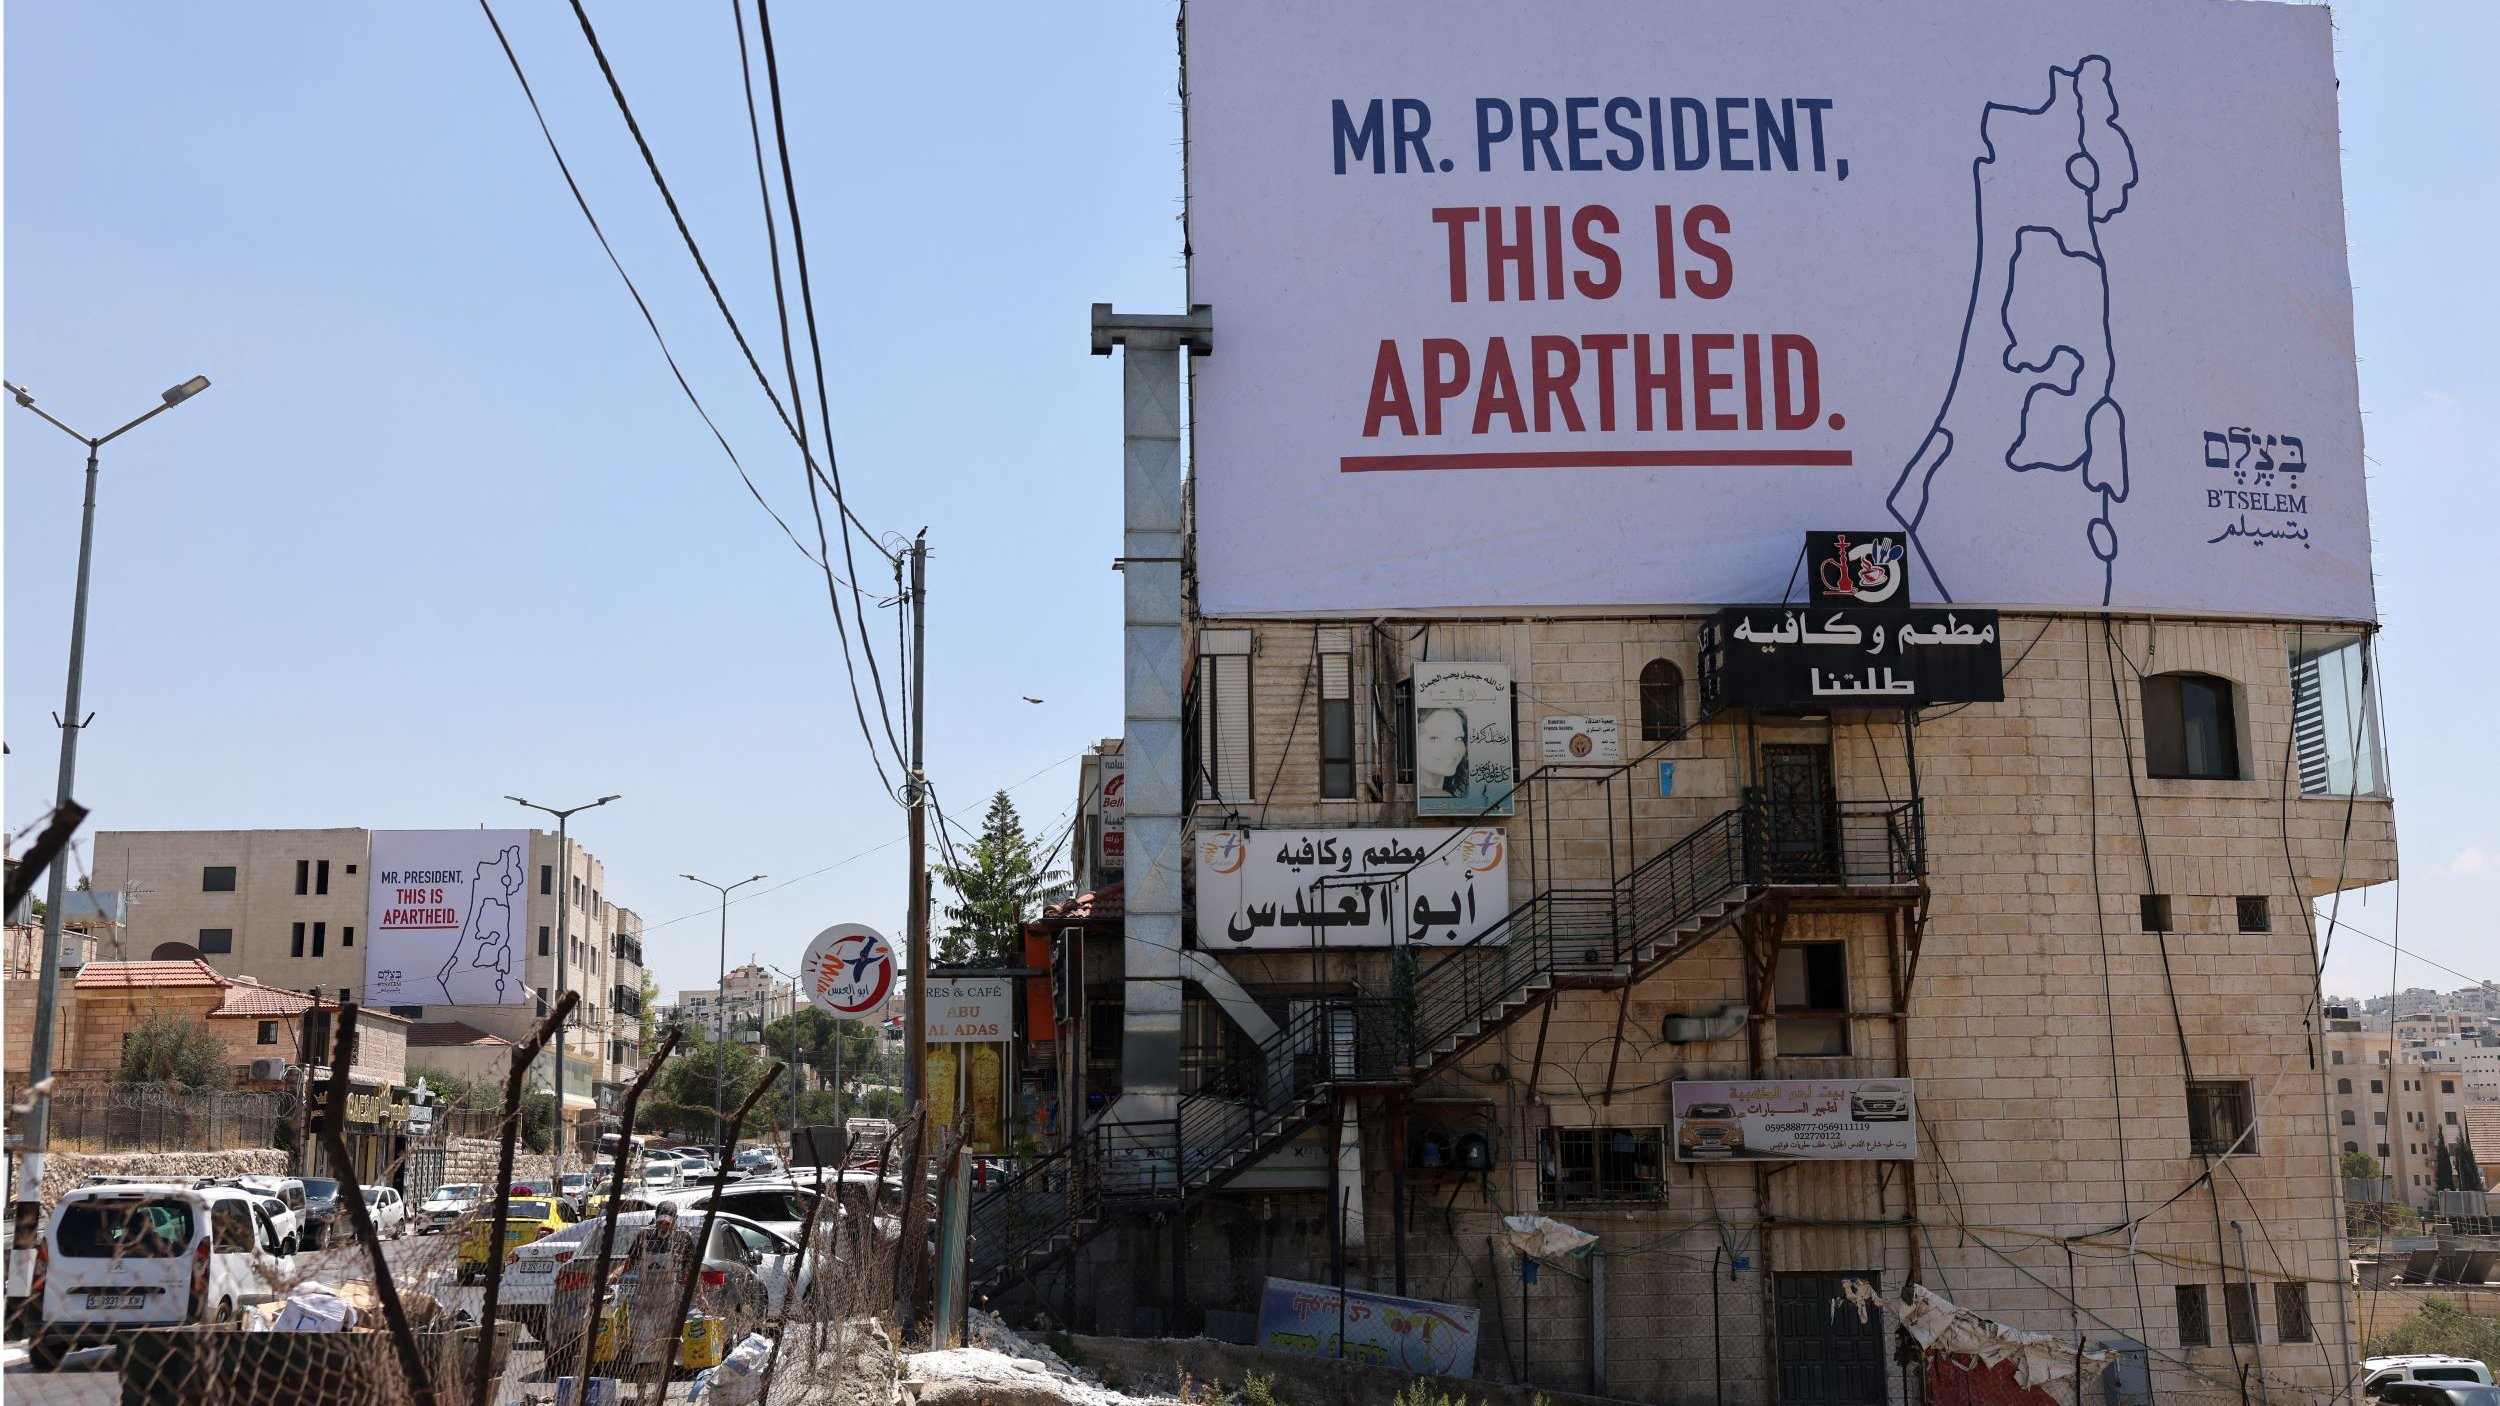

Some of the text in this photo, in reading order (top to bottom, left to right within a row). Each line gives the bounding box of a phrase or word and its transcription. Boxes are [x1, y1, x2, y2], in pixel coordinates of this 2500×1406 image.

[1332, 96, 1851, 181] MR. PRESIDENT,
[1432, 203, 1735, 303] THIS IS
[1362, 333, 1846, 438] APARTHEID.
[2207, 489, 2309, 514] B'TSELEM
[2207, 513, 2311, 550] بتسيلم
[1898, 613, 1996, 655] مطعم
[1419, 674, 1443, 693] الجمال
[1460, 670, 1482, 682] جميل
[1811, 667, 1916, 697] طلتنا
[1362, 837, 1427, 872] مطعم
[381, 870, 464, 884] MR. PRESIDENT,
[396, 888, 443, 904] THIS IS
[1227, 869, 1477, 942] أبو العدس
[383, 908, 459, 925] APARTHEID.
[848, 995, 853, 1006] 1
[857, 984, 870, 998] ابو
[953, 988, 964, 998] &
[947, 1006, 980, 1018] ABU
[928, 1024, 999, 1036] AL ADAS
